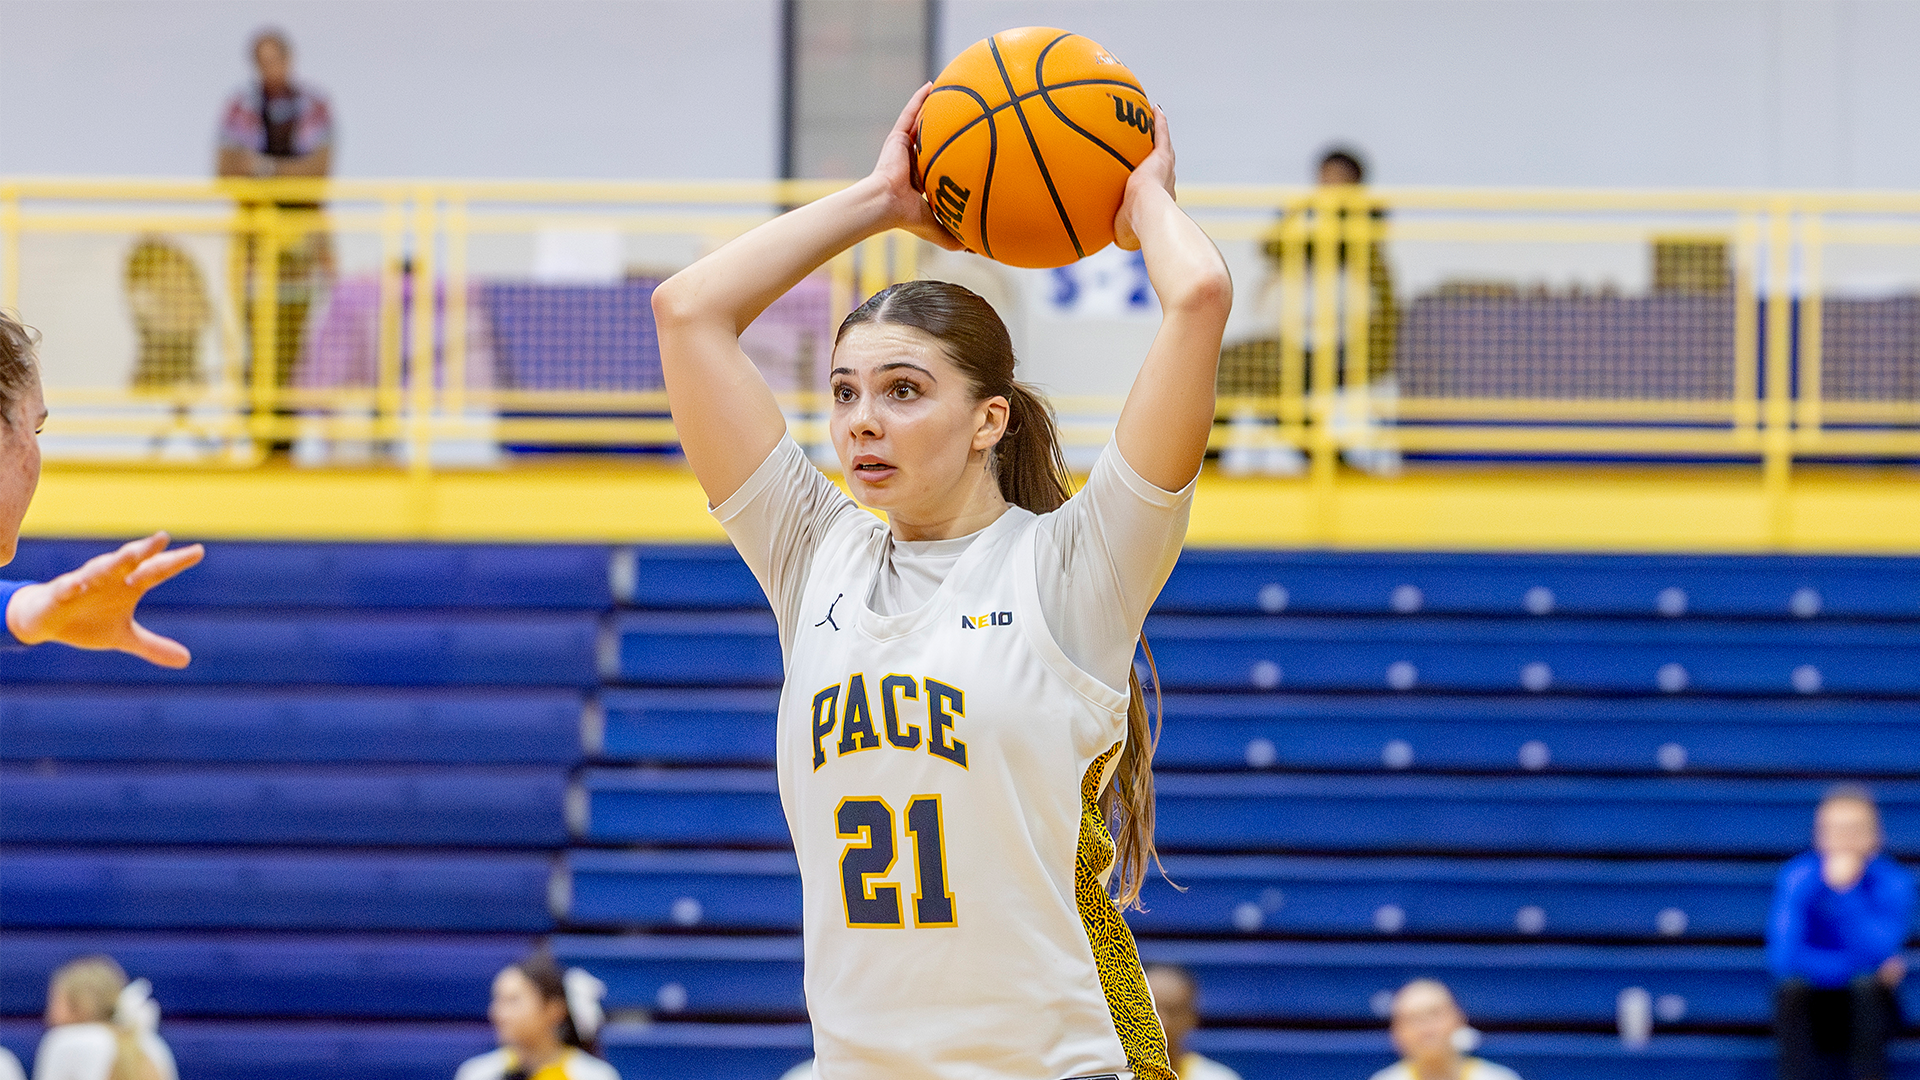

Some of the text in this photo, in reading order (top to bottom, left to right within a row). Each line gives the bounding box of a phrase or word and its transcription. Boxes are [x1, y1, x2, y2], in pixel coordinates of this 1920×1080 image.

[962, 611, 1013, 629] NE10
[811, 672, 969, 774] PACE
[834, 793, 958, 930] 21
